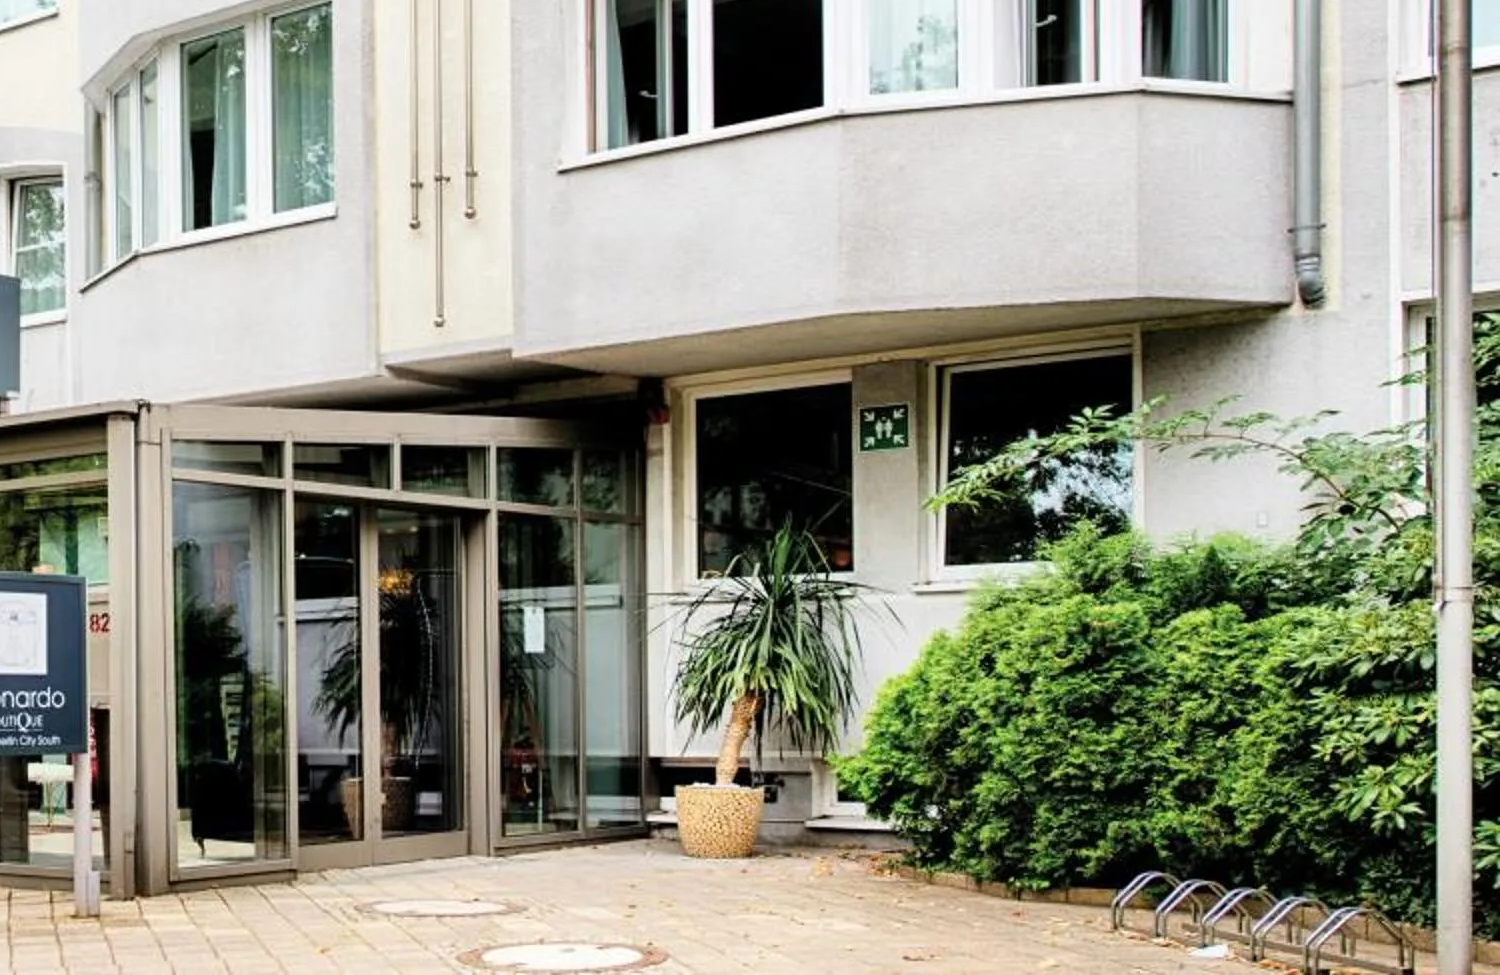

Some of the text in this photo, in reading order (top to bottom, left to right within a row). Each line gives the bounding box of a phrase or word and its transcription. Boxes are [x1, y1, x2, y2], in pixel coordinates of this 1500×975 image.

[89, 612, 111, 633] 82
[19, 735, 37, 747] City
[37, 735, 61, 747] South
